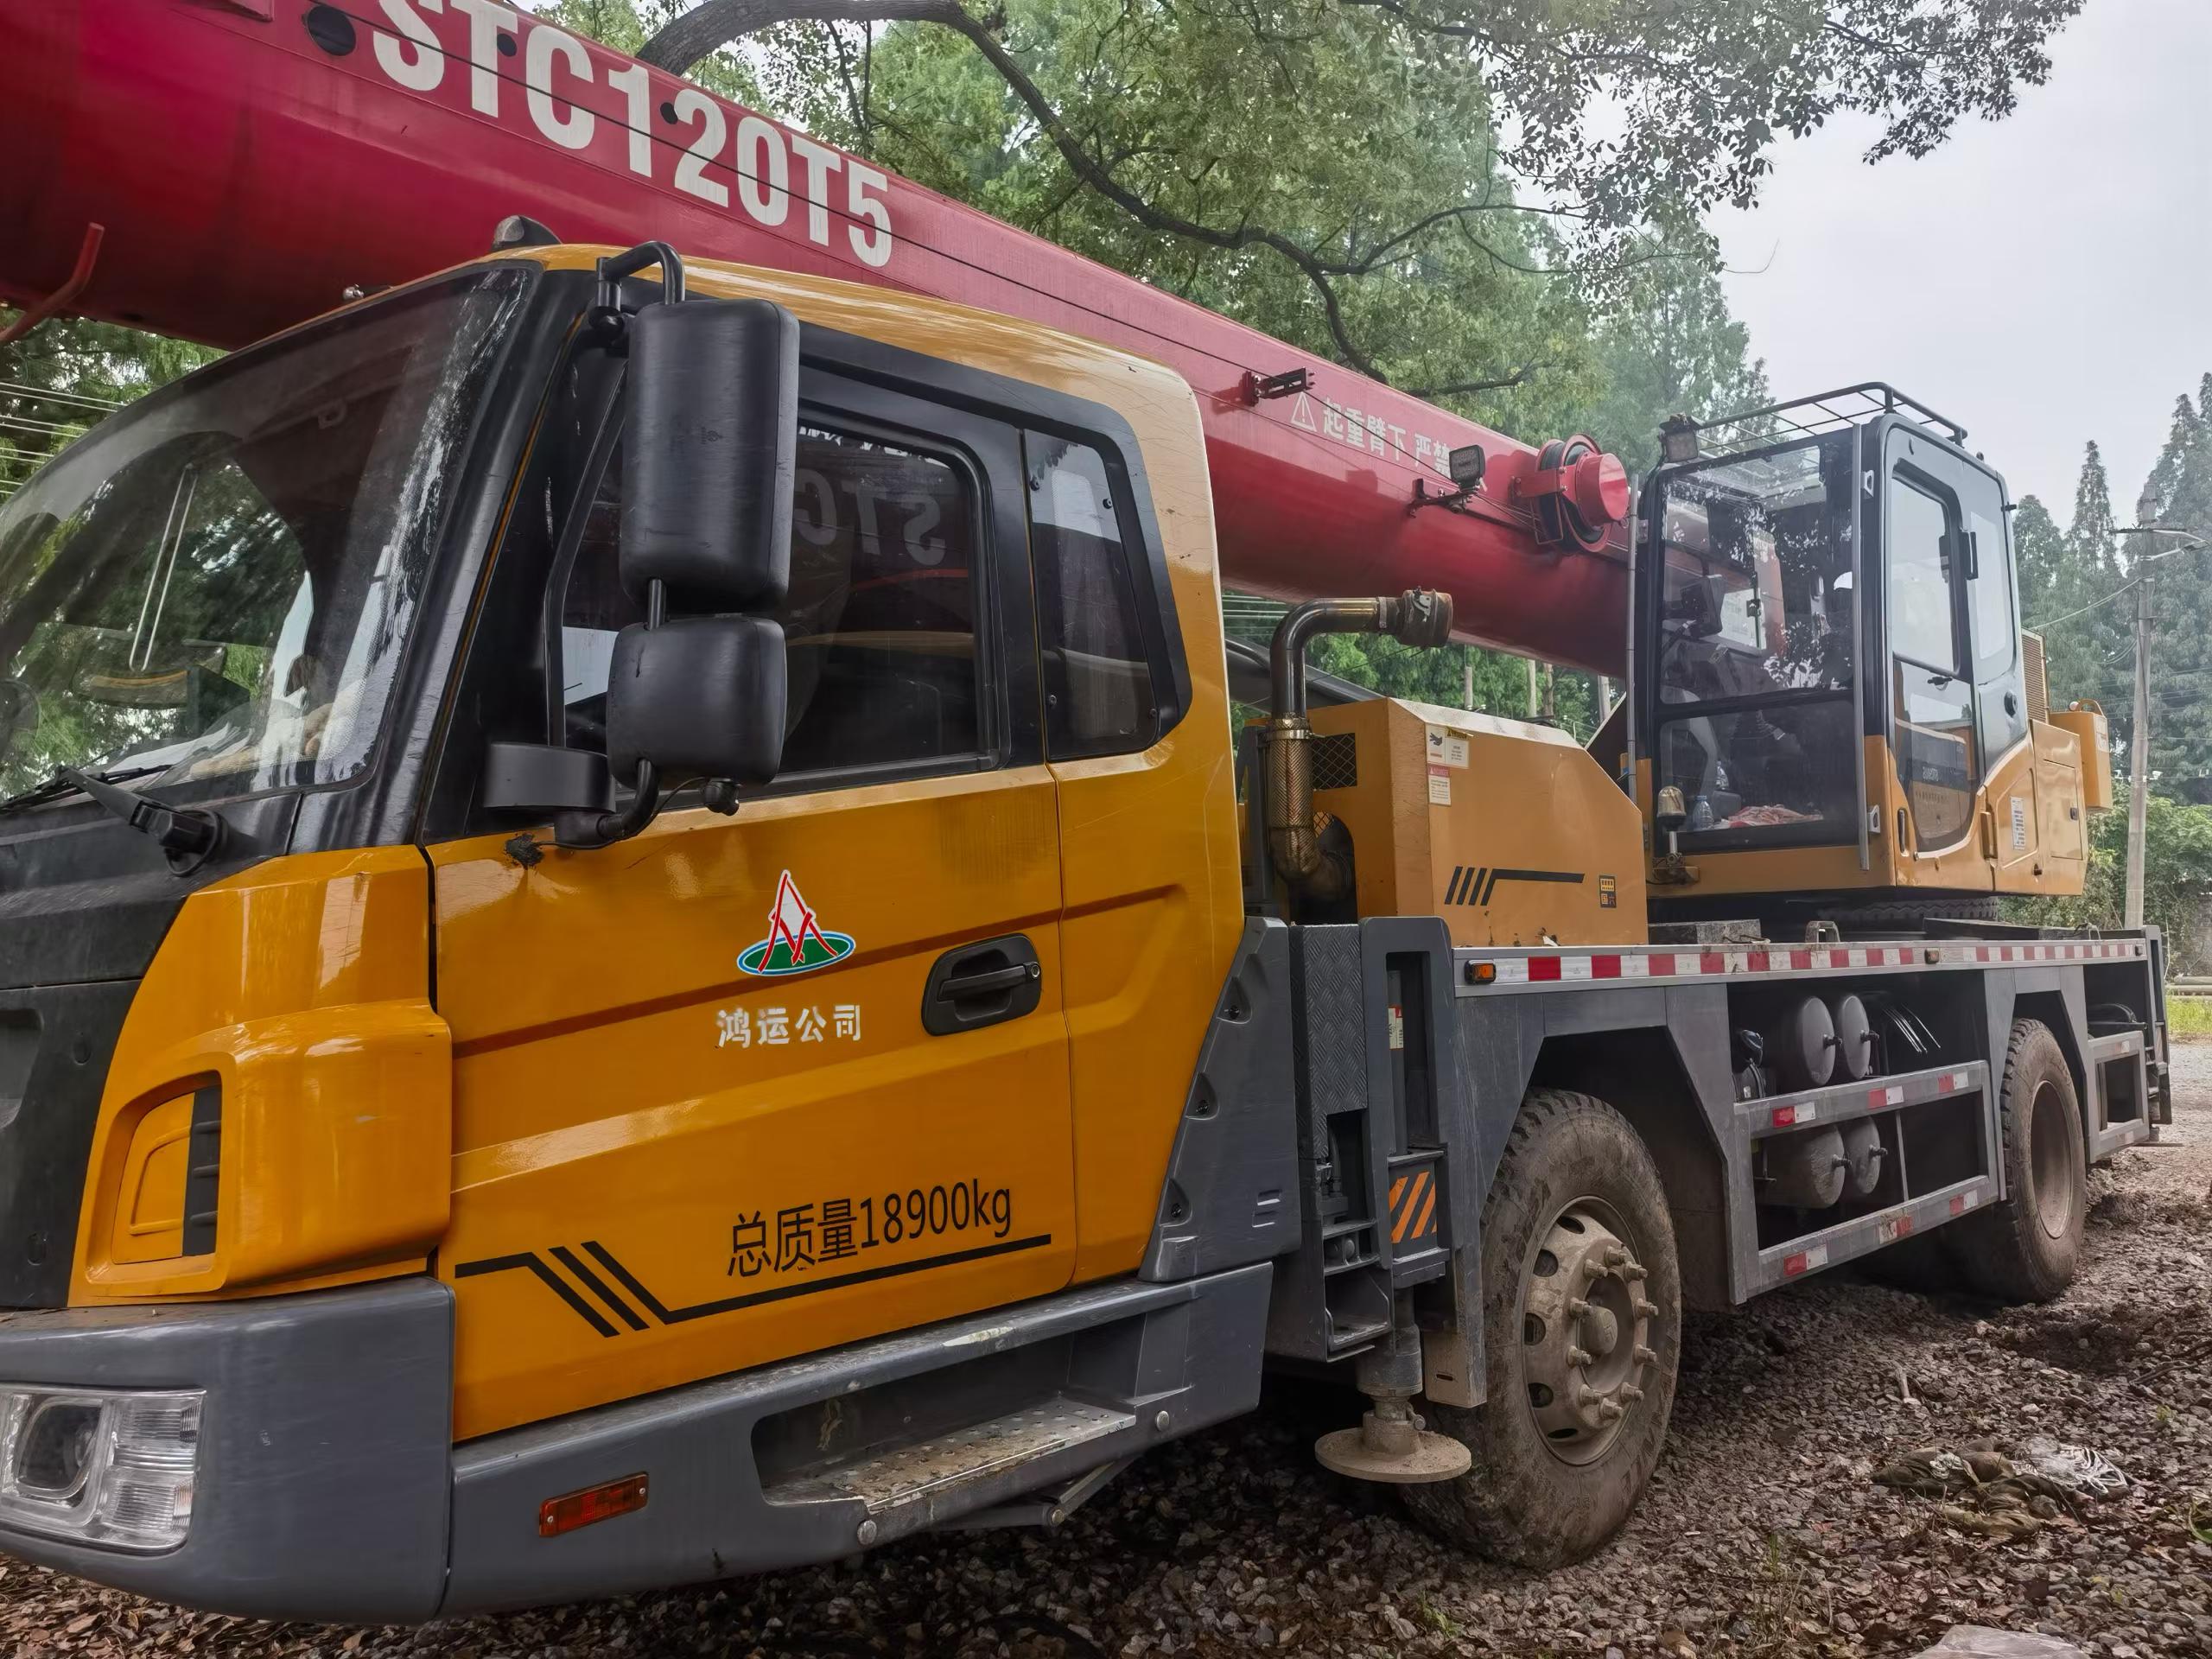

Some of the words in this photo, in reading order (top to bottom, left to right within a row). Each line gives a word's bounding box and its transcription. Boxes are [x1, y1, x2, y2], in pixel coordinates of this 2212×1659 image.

[372, 0, 892, 267] STC120T5
[1323, 397, 1406, 461] 起重臂下
[715, 1004, 861, 1048] 鸿运公司
[728, 1179, 1011, 1277] 总质量18900kg
